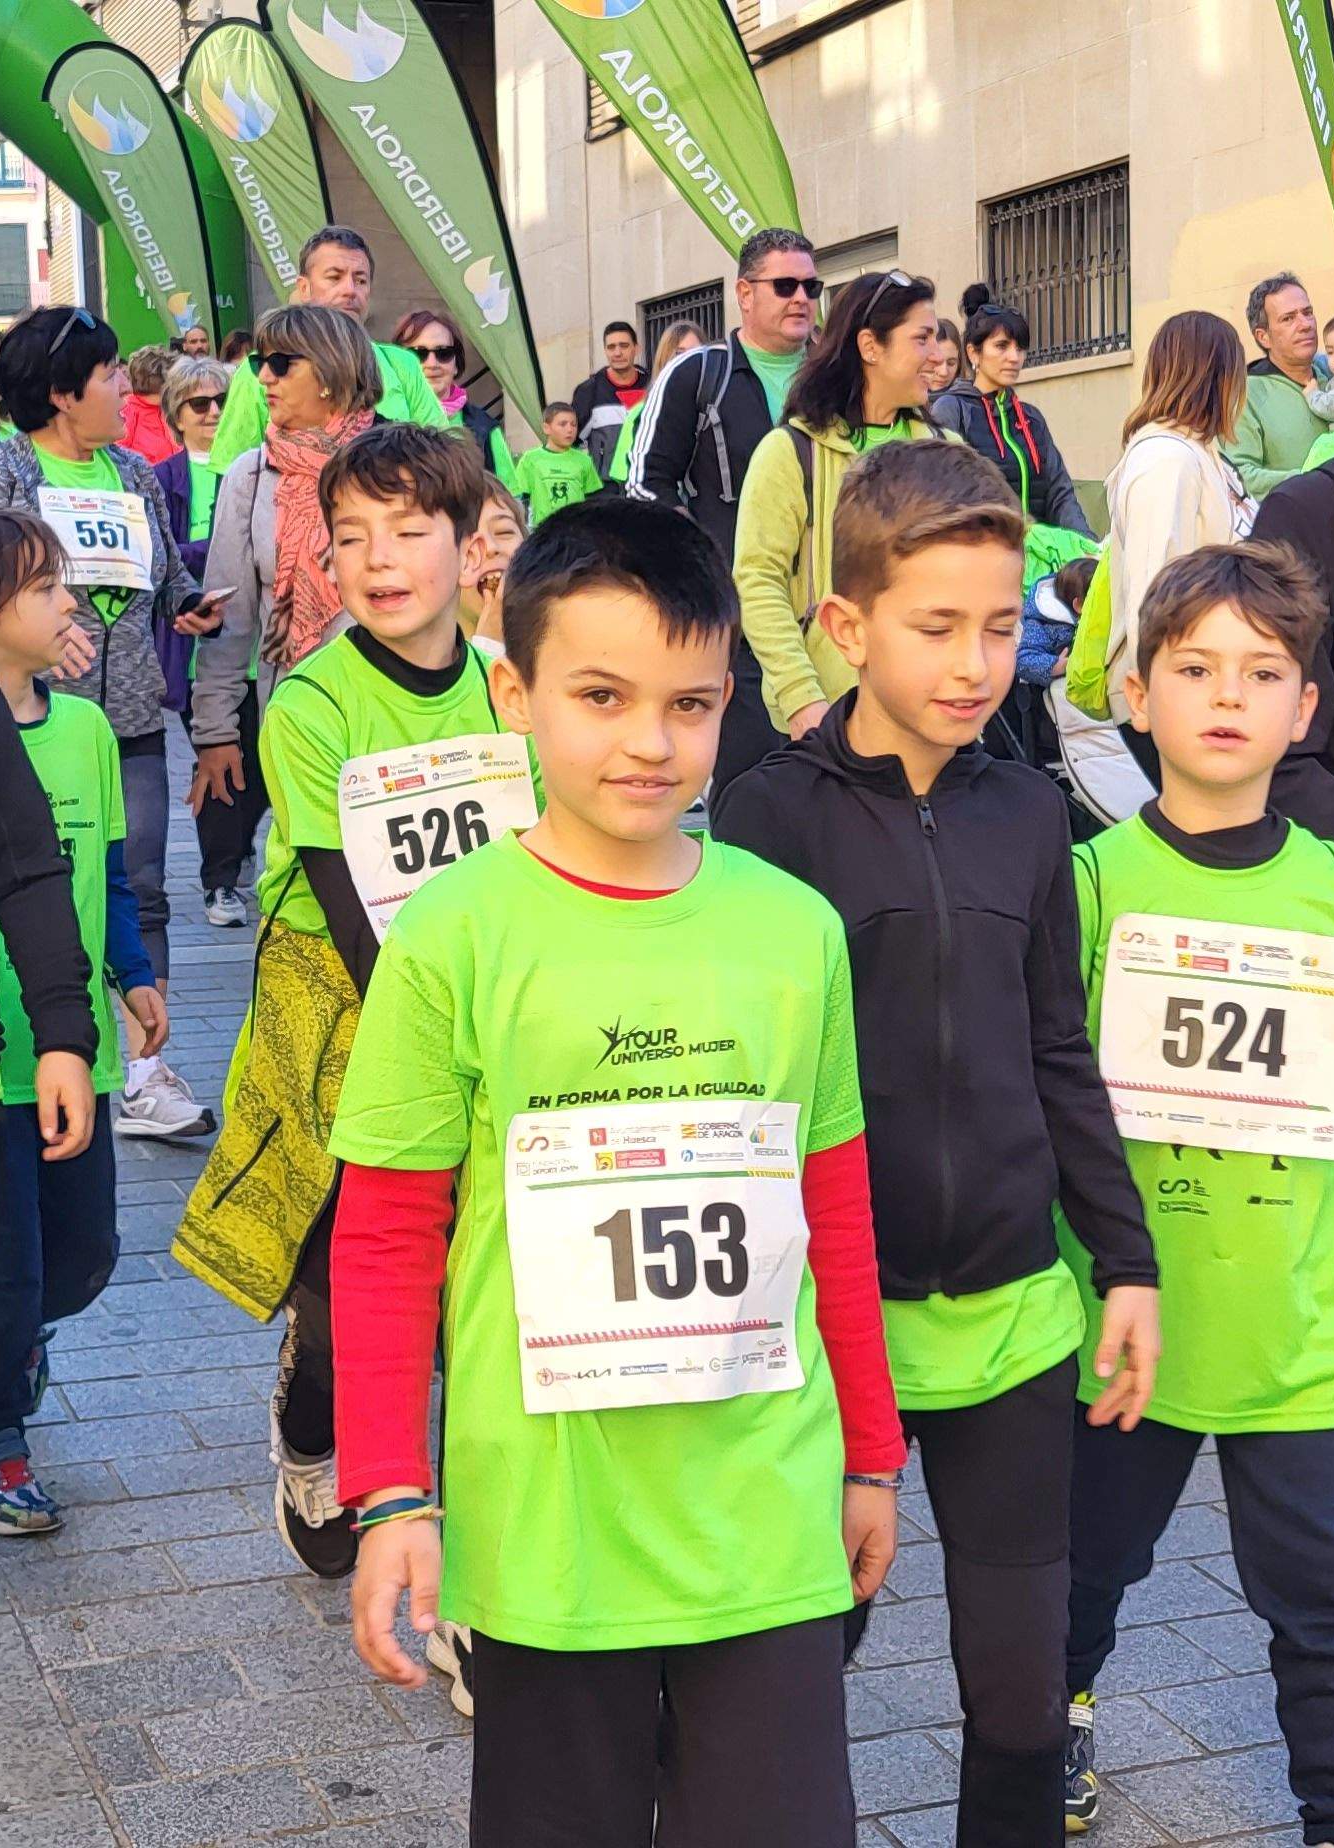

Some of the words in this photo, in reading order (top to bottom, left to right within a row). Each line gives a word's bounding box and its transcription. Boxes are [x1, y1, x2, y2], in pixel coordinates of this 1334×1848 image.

[75, 520, 129, 552] 557
[386, 800, 490, 874] 526
[611, 1046, 684, 1065] UNIVERSO
[689, 1040, 735, 1055] MUJER
[621, 1028, 677, 1050] TOUR
[1162, 996, 1286, 1077] 524
[528, 1095, 551, 1109] EN
[555, 1089, 621, 1107] FORMA
[626, 1087, 663, 1100] POR
[668, 1085, 690, 1097] LA
[695, 1082, 765, 1096] IGUALDAD
[594, 1202, 749, 1302] 153
